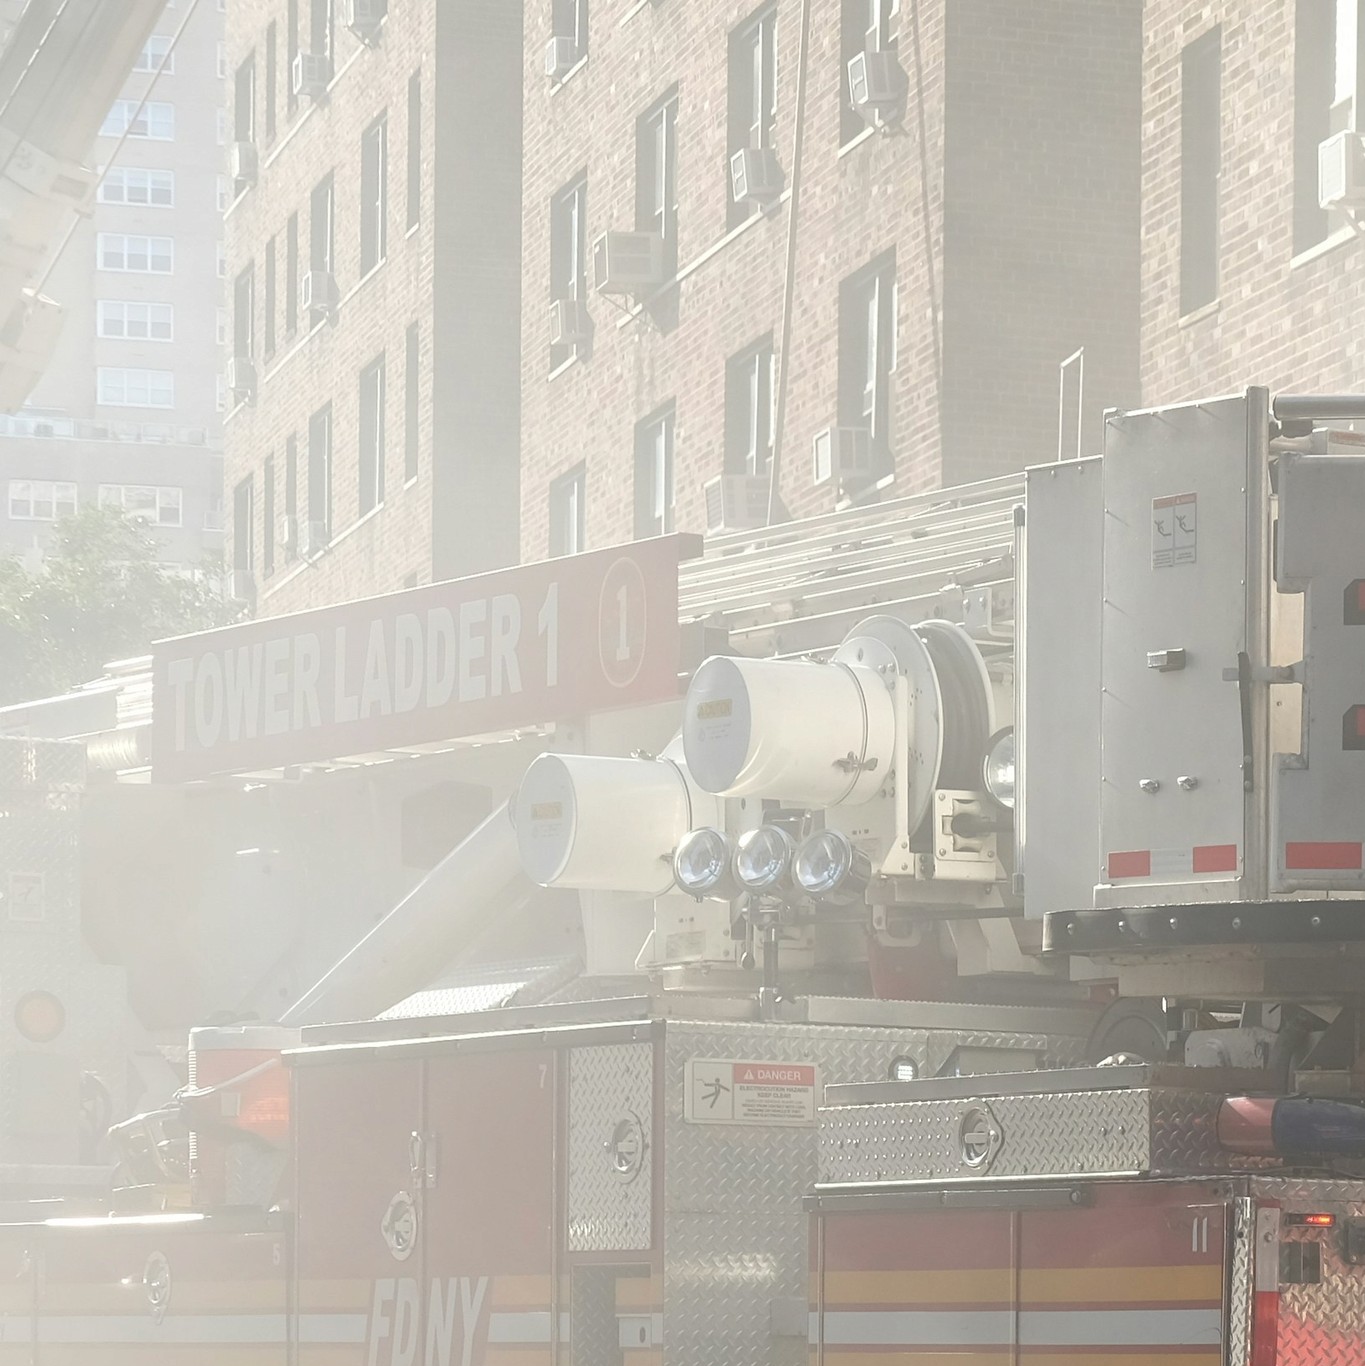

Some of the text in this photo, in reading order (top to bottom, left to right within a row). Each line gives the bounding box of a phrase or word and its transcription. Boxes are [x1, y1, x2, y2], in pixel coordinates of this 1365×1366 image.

[615, 584, 630, 660] 1
[167, 582, 559, 751] TOWER LADDER 1
[757, 1070, 801, 1081] DANGER
